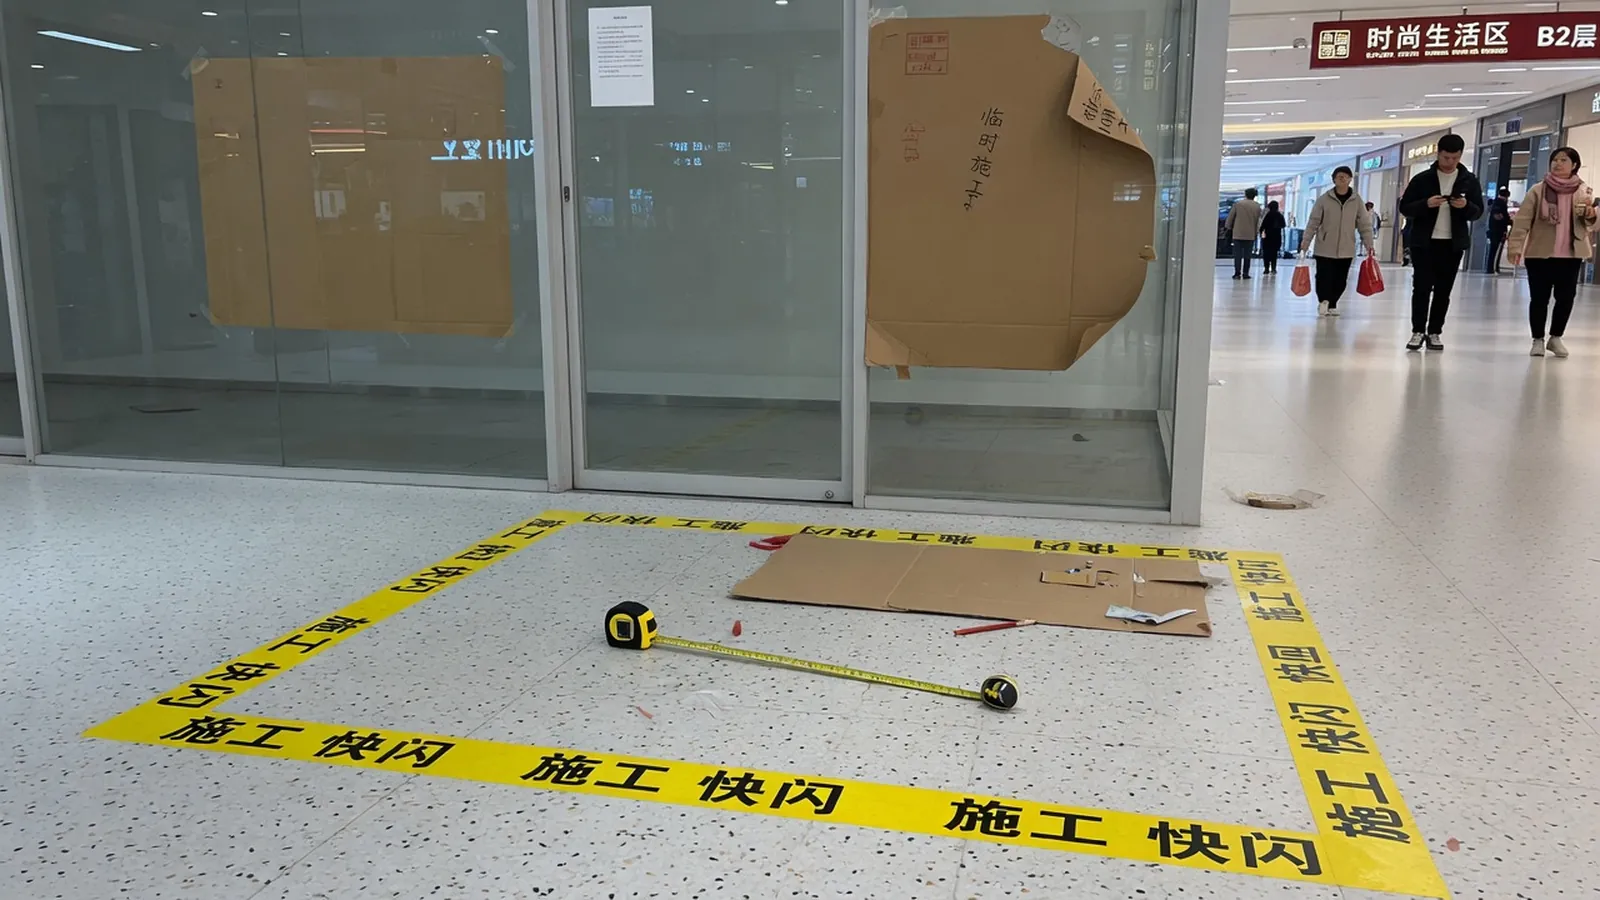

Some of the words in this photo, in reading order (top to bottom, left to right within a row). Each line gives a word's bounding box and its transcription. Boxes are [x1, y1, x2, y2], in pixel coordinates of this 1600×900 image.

[1367, 22, 1510, 49] 时尚生活区
[1537, 24, 1597, 48] B2层
[267, 615, 370, 653] 施工
[158, 663, 280, 708] 快闪
[1288, 702, 1369, 754] 快闪
[160, 716, 304, 750] 施工
[313, 731, 455, 768] 快闪
[520, 753, 670, 792] 施工
[699, 770, 844, 814] 快闪
[944, 800, 1104, 846] 施工
[1147, 822, 1322, 875] 快闪
[1315, 770, 1410, 844] 施工
